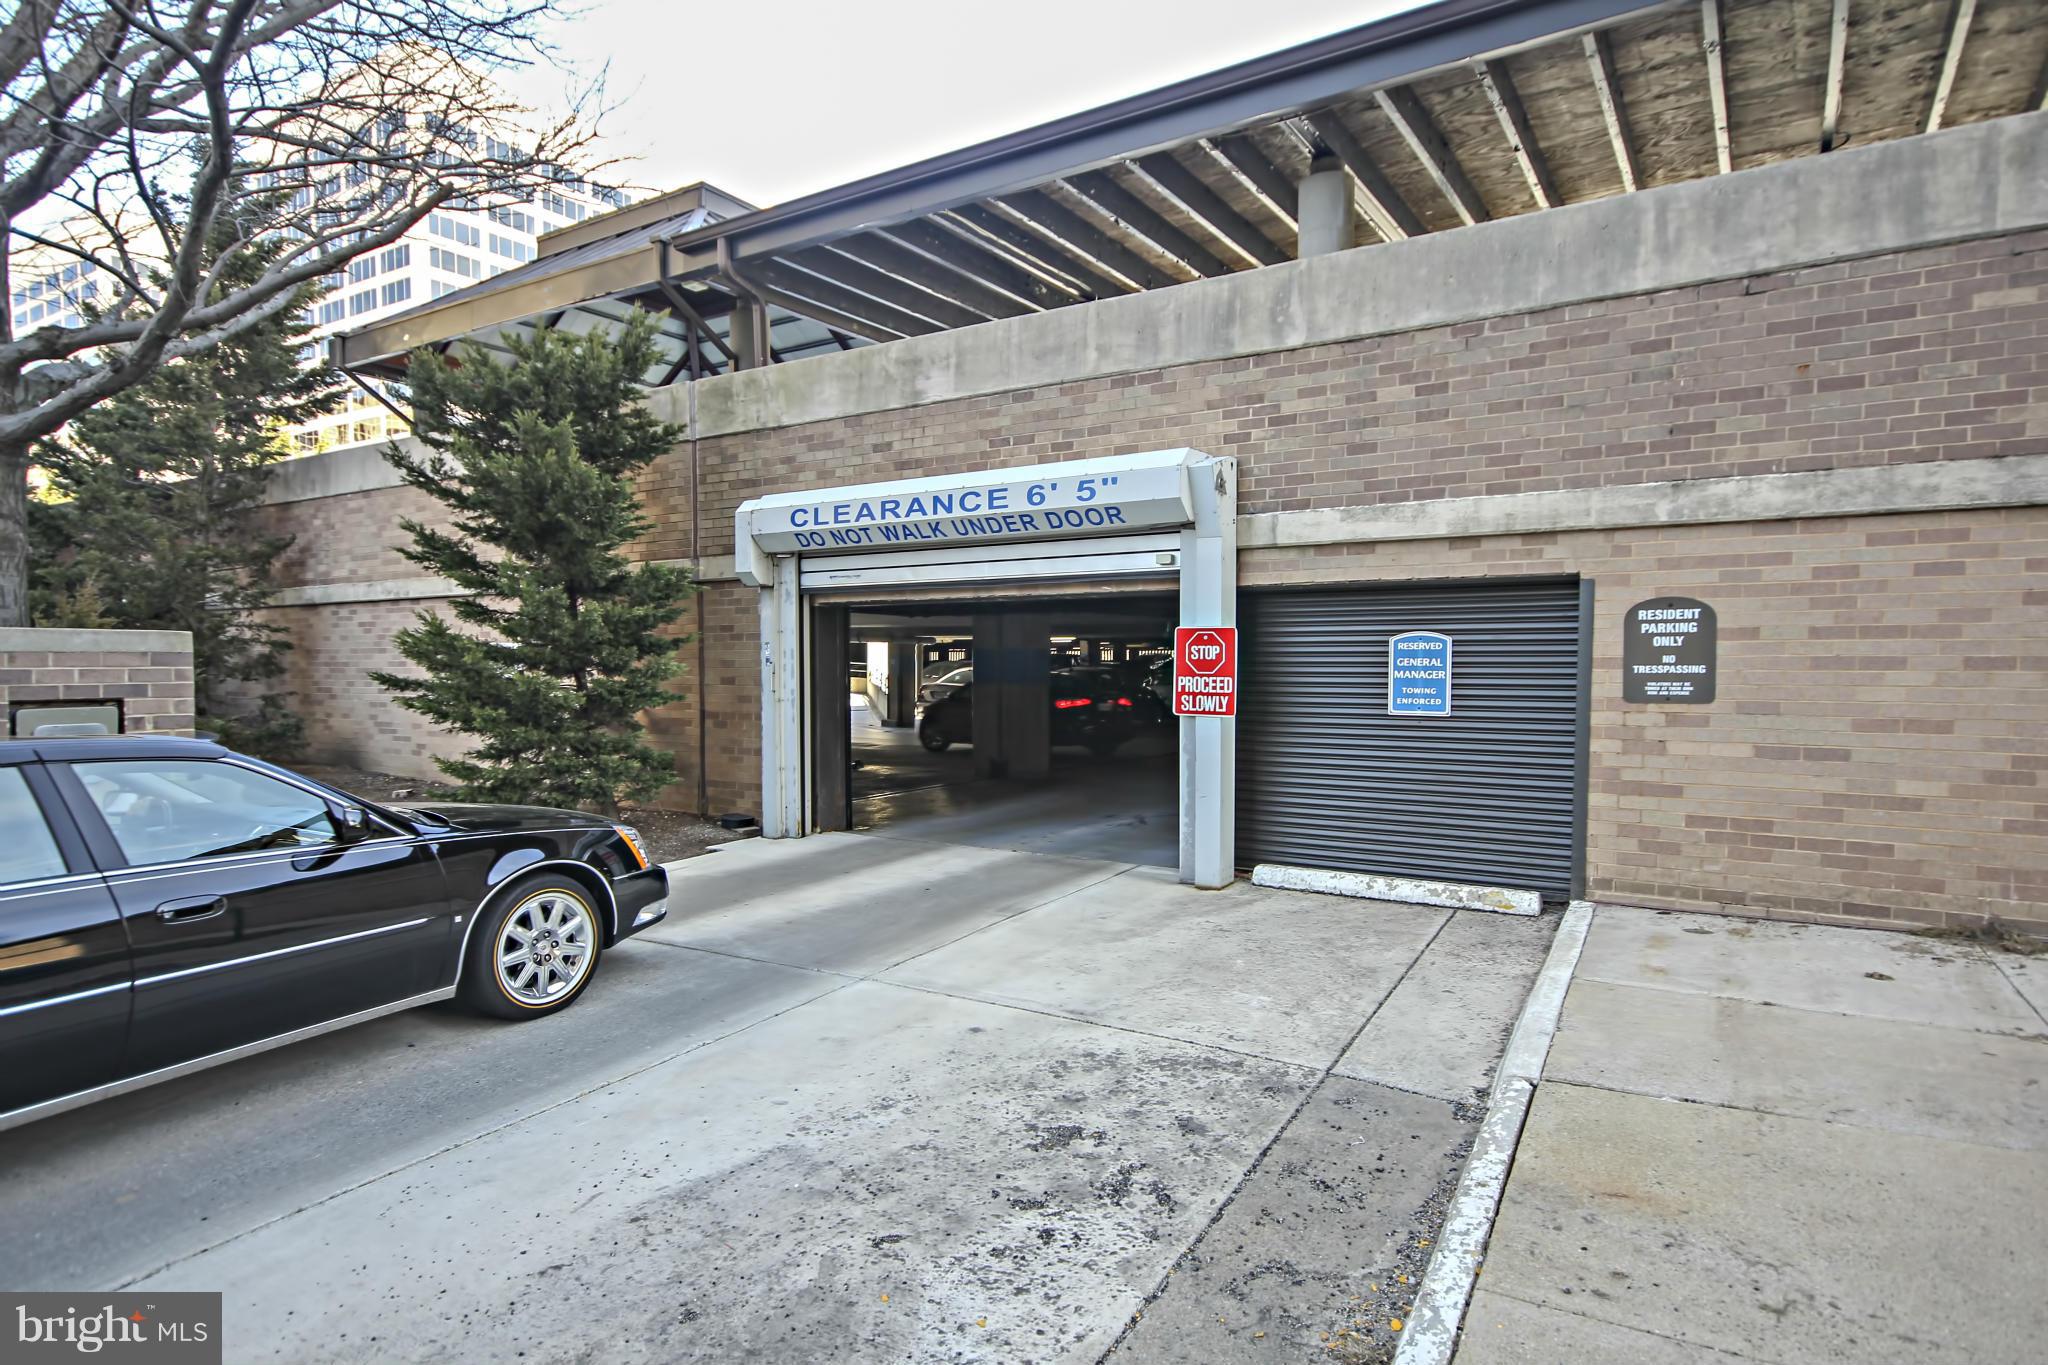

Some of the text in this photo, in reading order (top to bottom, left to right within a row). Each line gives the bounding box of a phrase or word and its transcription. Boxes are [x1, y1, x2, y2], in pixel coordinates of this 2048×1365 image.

[790, 487, 1009, 527] CLEARANCE
[1026, 482, 1058, 507] 6'
[794, 506, 1126, 548] DO NOT WALK UNDER DOOR
[1638, 608, 1701, 620] RESIDENT
[1641, 622, 1698, 634] PARKING
[1397, 642, 1443, 650] RESERVED
[1652, 636, 1684, 647] ONLY
[1190, 645, 1220, 660] STOP
[1396, 657, 1443, 667] GENERAL
[1662, 655, 1676, 663] NO
[1394, 670, 1446, 679] MANAGER
[1632, 665, 1706, 674] TRESSPASSING
[1177, 676, 1233, 693] PROCEED
[1402, 687, 1437, 695] TOWING
[1181, 694, 1229, 712] SLOWLY
[1396, 697, 1442, 705] ENFORCED
